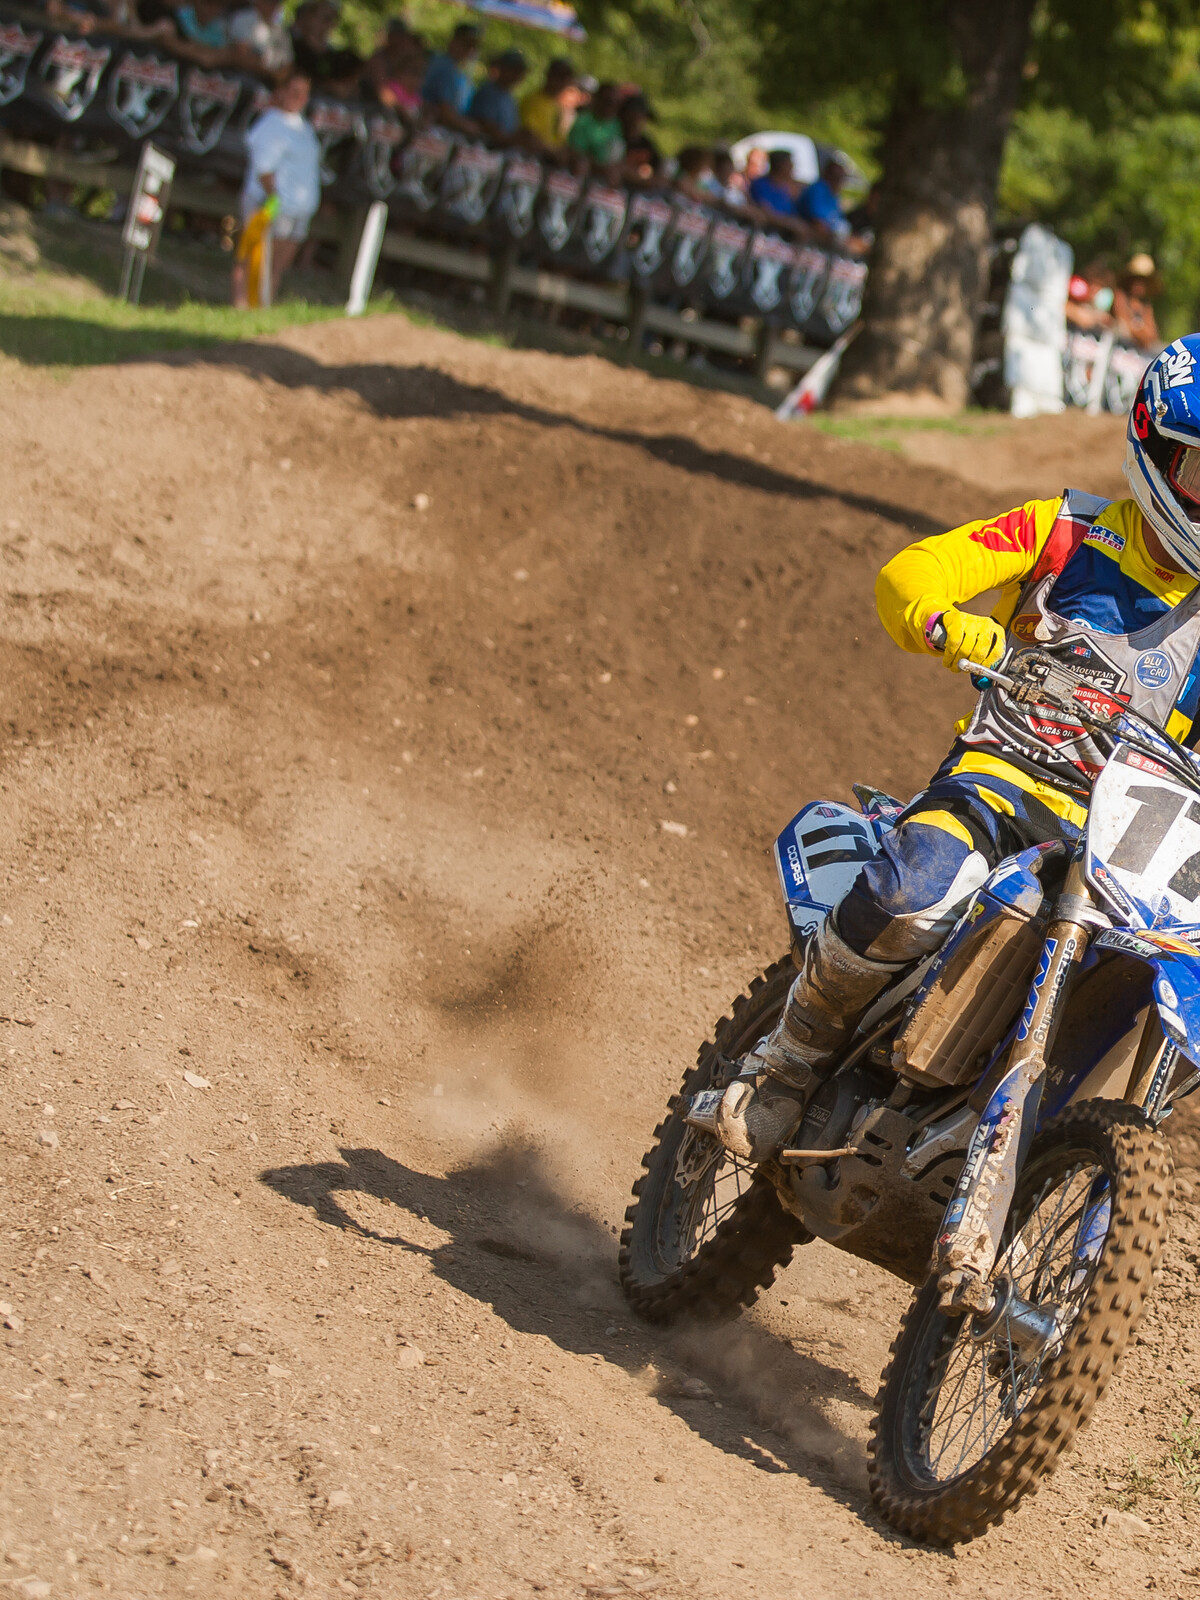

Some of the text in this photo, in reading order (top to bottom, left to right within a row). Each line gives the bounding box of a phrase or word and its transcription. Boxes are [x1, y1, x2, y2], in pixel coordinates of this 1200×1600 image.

[1084, 533, 1123, 551] IMITED
[1089, 525, 1126, 547] RTS
[1154, 567, 1175, 583] THOR
[1073, 689, 1099, 700] ATIONAL
[1036, 725, 1062, 736] LUCAS
[787, 844, 805, 886] COOPER
[957, 1121, 990, 1193] TAMER
